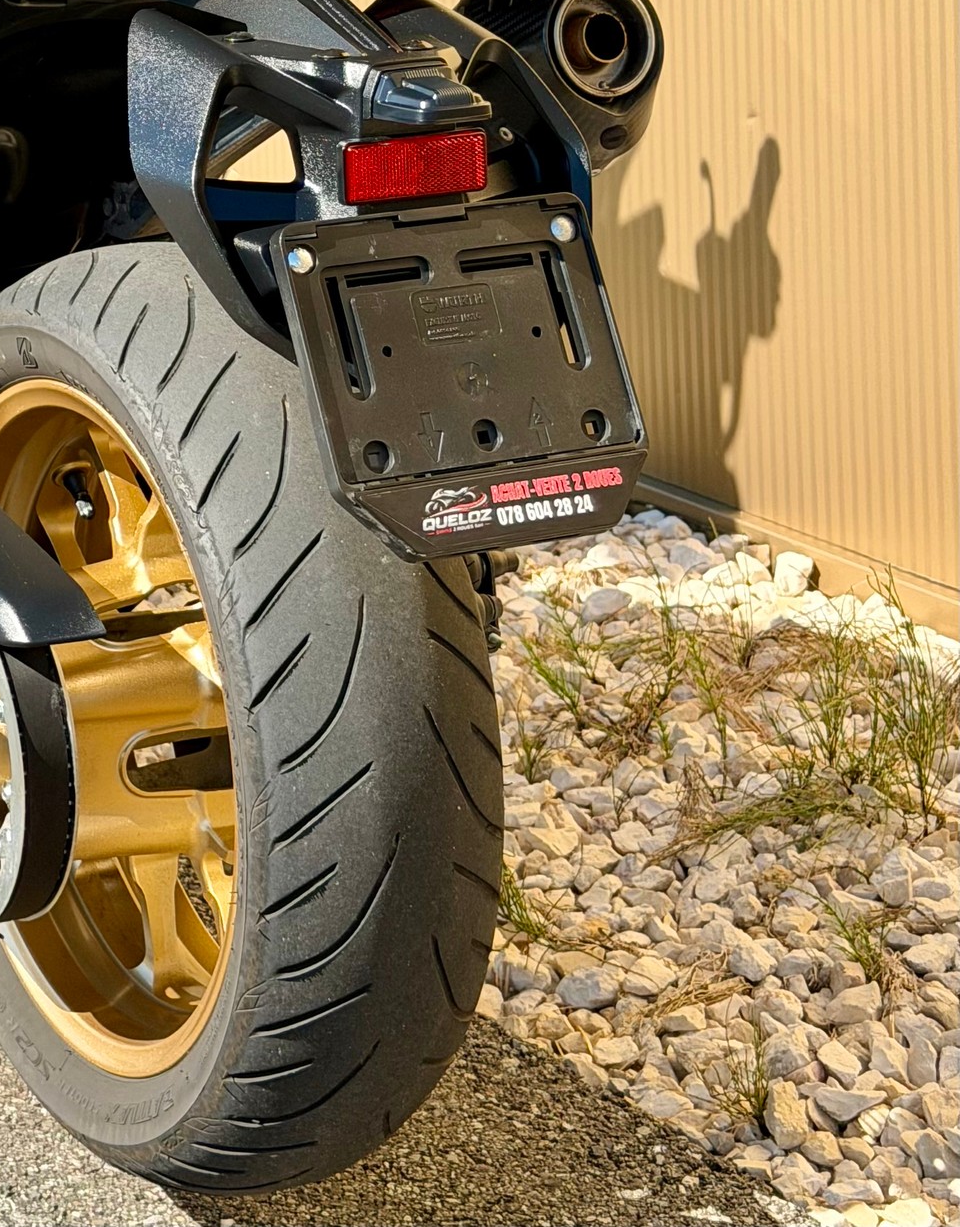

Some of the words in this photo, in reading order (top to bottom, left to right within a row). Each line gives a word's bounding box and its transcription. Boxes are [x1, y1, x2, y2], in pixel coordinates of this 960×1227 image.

[571, 473, 584, 492] 2
[584, 467, 624, 490] ROUES
[422, 508, 493, 532] QUELOZ
[496, 504, 526, 527] 078
[526, 500, 554, 522] 604
[554, 497, 573, 518] 28
[574, 494, 595, 515] 24
